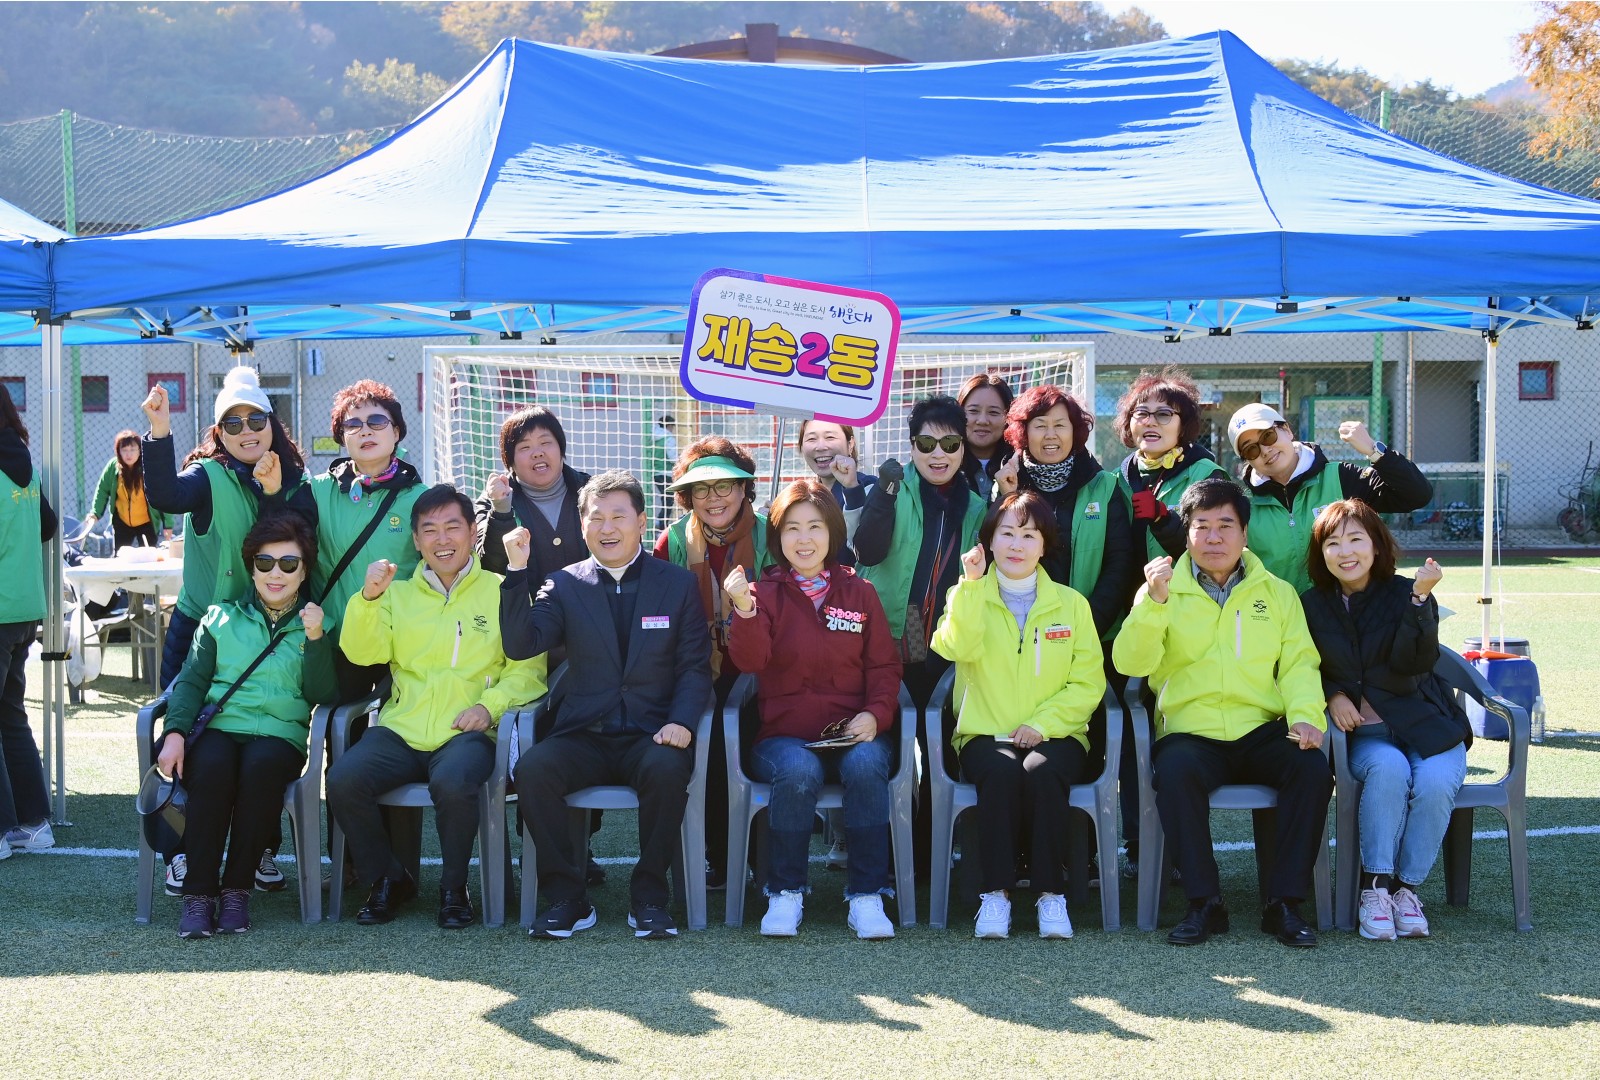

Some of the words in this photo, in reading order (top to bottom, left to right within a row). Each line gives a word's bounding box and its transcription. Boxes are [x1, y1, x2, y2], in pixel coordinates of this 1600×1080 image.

[720, 290, 736, 300] 살기
[738, 293, 753, 304] 좋은
[755, 295, 773, 307] 도시,
[775, 299, 791, 308] 오고
[793, 302, 808, 313] 싶은
[810, 304, 826, 315] 도시
[829, 305, 873, 325] 해운대
[697, 313, 879, 391] 재송2동
[825, 614, 863, 634] 김미애
[829, 606, 862, 623] 국회의원
